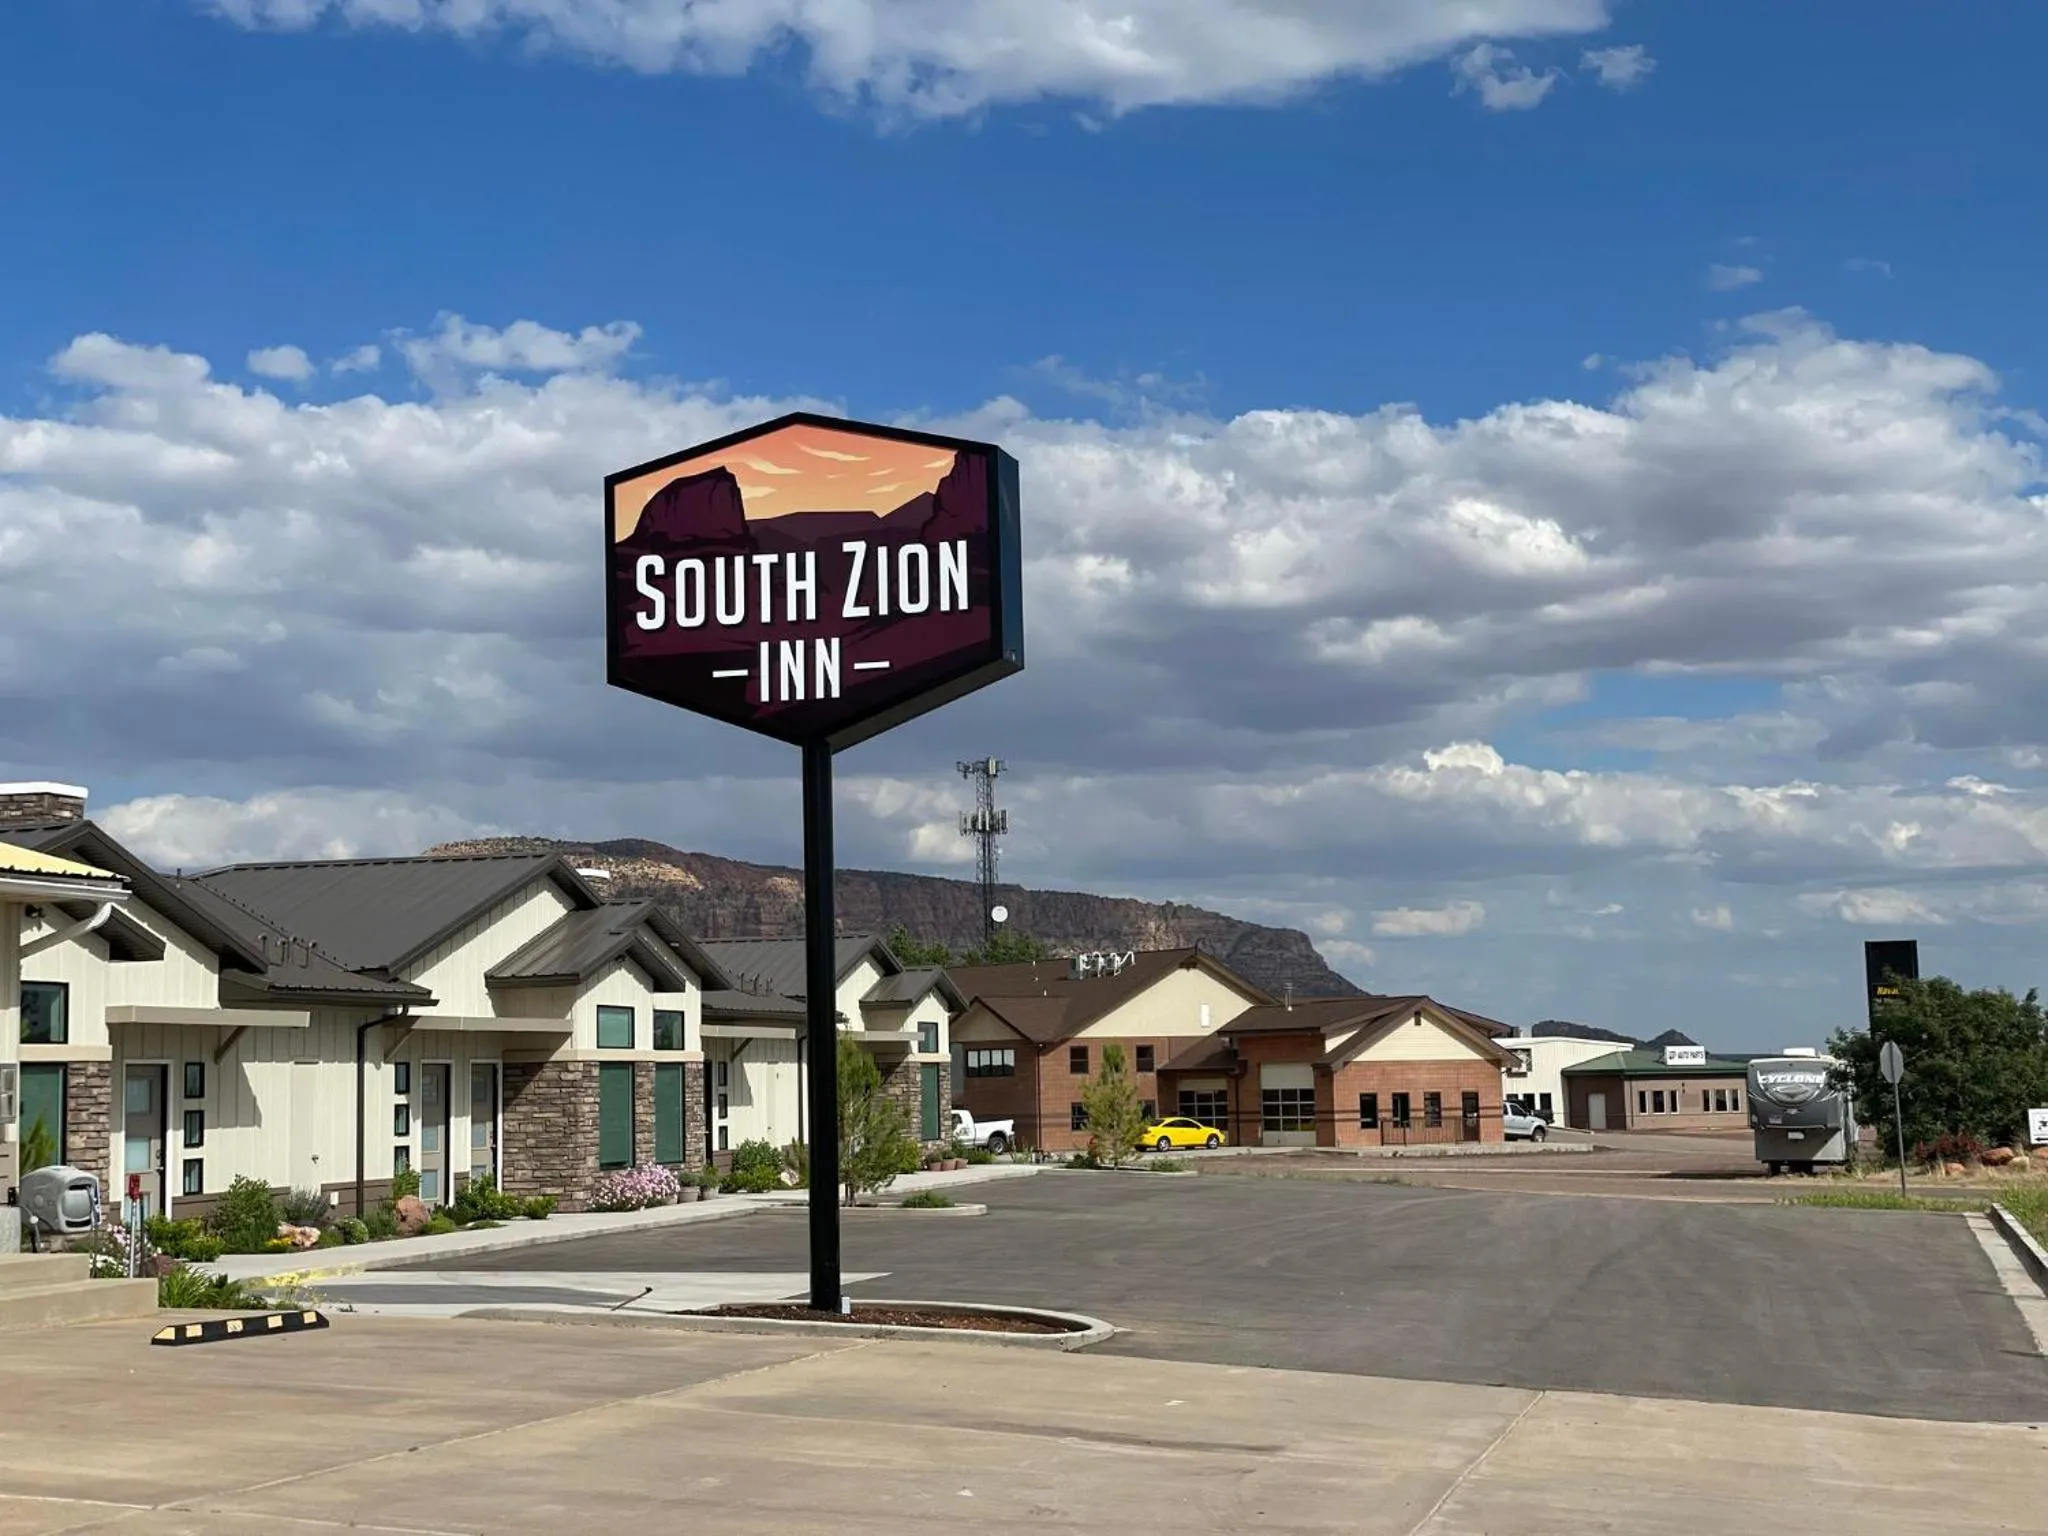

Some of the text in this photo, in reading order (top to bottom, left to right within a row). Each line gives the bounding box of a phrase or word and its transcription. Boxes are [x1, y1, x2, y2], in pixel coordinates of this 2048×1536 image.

[635, 540, 969, 630] SOUTH ZION
[1758, 1072, 1825, 1084] CYCLONE
